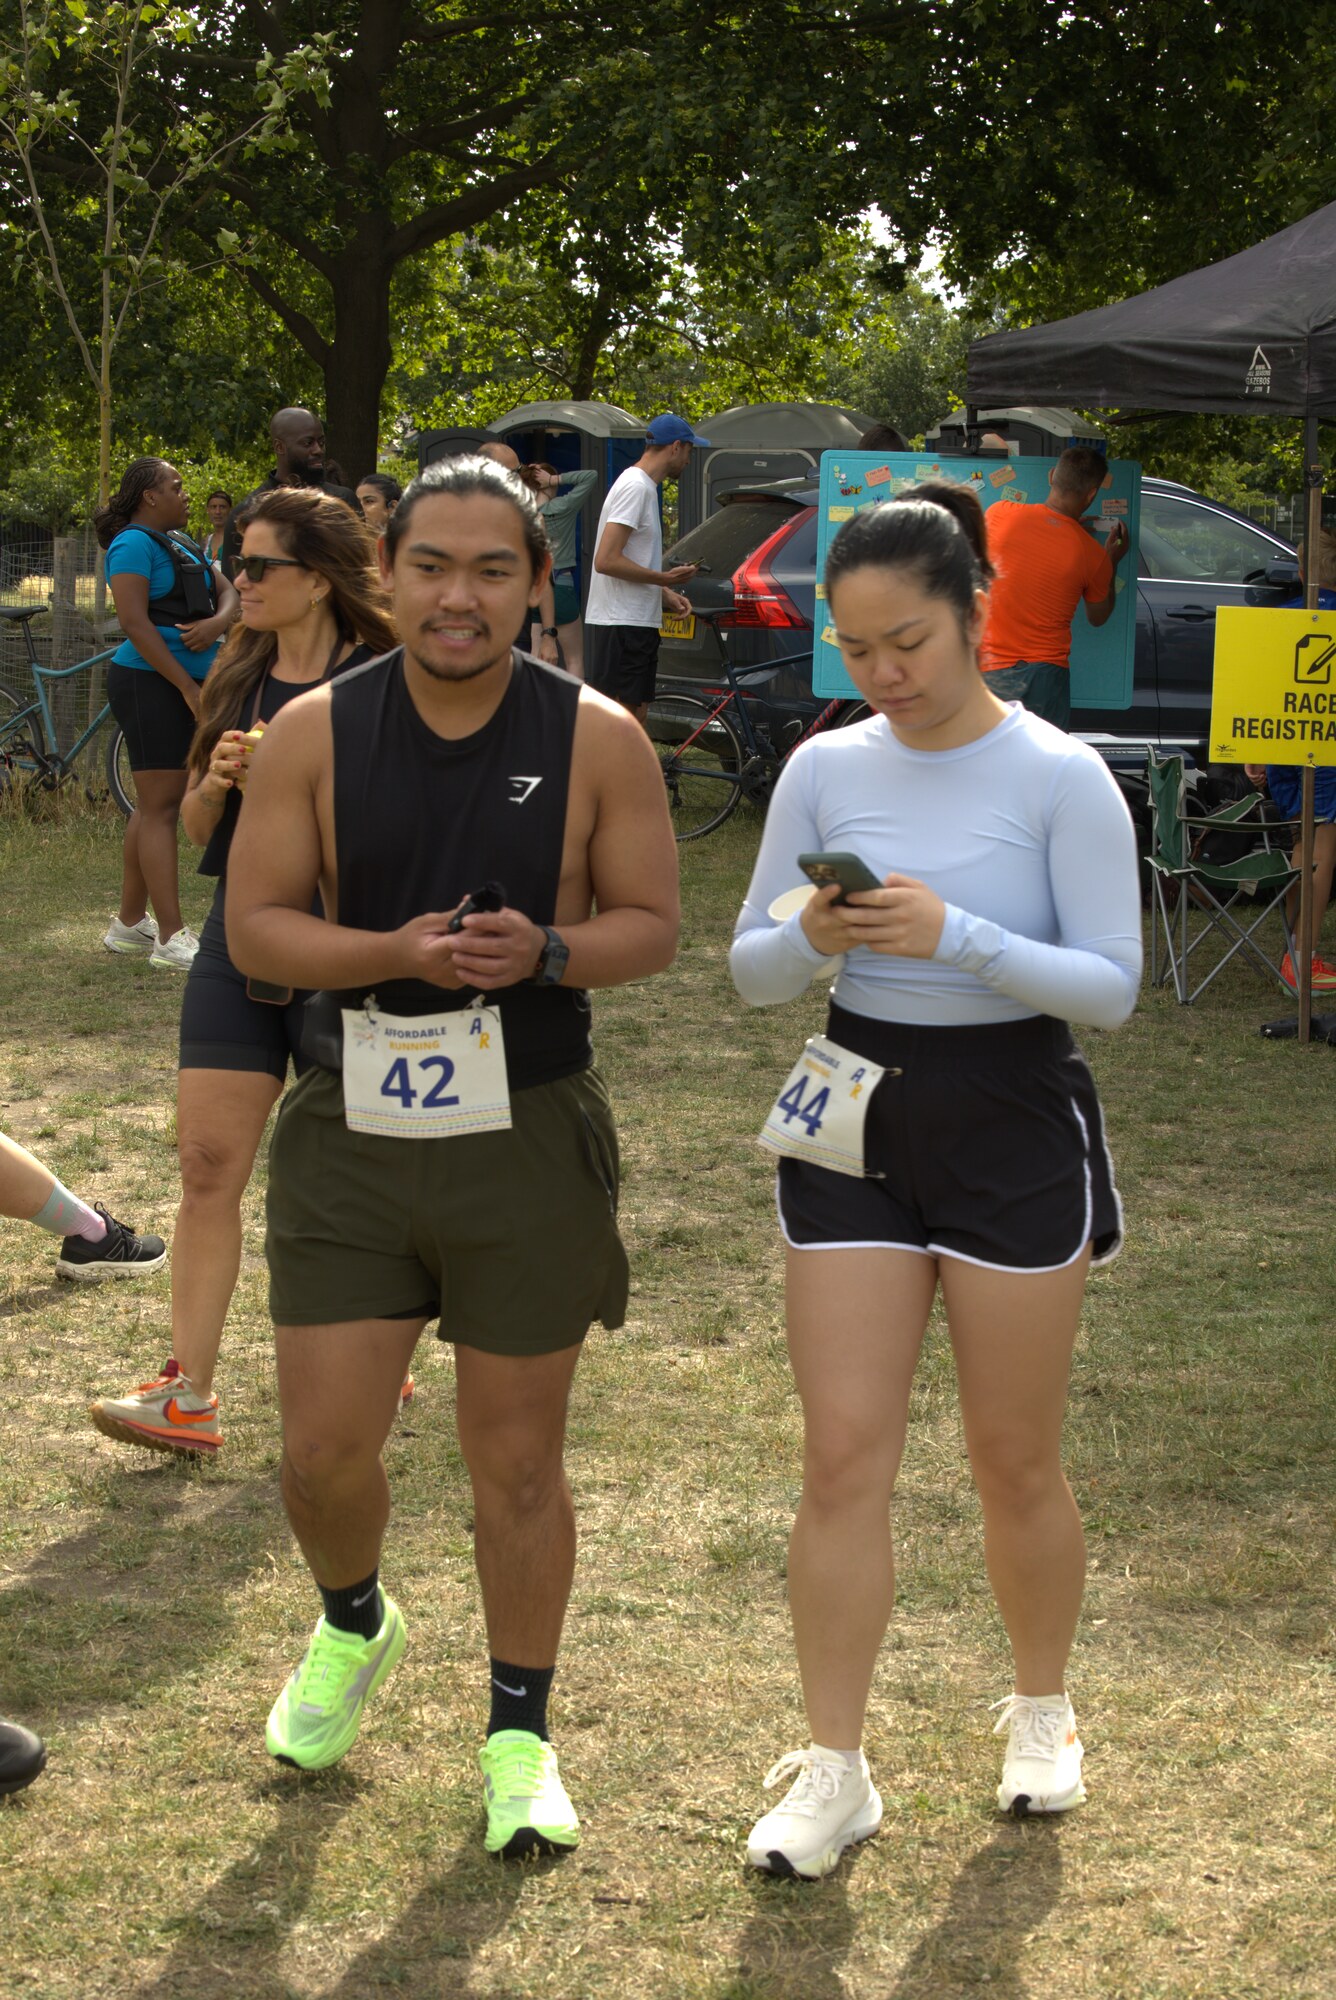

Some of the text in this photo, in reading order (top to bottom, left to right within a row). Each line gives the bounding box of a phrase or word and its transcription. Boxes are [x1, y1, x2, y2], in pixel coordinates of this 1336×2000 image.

[1245, 377, 1271, 385] GAZEBOS
[1284, 692, 1336, 714] RACE
[384, 1027, 447, 1038] AFFORDABLE
[389, 1041, 440, 1051] RUNNING
[380, 1055, 460, 1109] 42
[777, 1075, 831, 1137] 44
